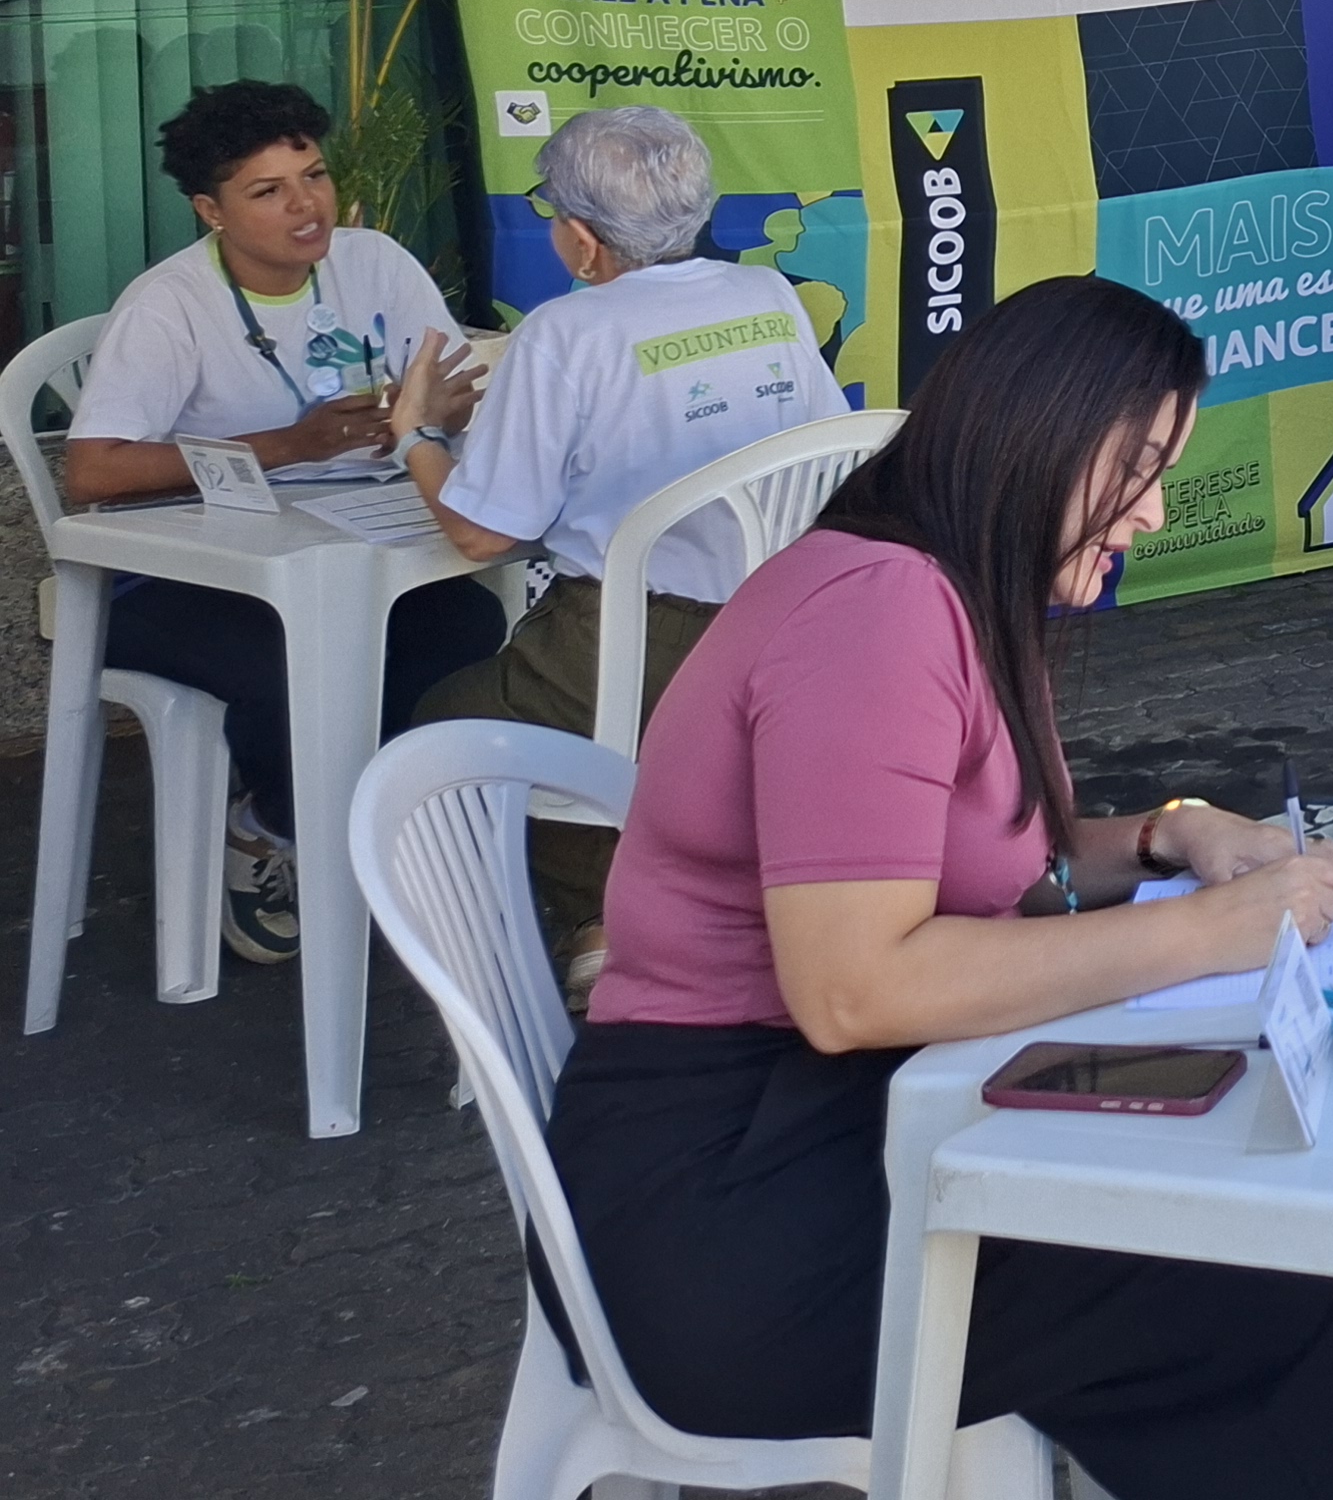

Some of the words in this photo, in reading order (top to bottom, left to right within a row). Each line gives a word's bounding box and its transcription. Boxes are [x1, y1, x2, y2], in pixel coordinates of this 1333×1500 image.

[515, 8, 768, 52] CONHECER
[775, 16, 811, 51] O
[526, 48, 823, 99] cooperativismo.
[924, 167, 966, 334] SICOOB
[1144, 189, 1333, 287] MAIS
[1214, 275, 1290, 315] uma
[684, 400, 730, 423] SICOOB
[1162, 460, 1261, 508] TERESSE
[1133, 512, 1266, 561] comunidade
[1166, 493, 1233, 533] PELA
